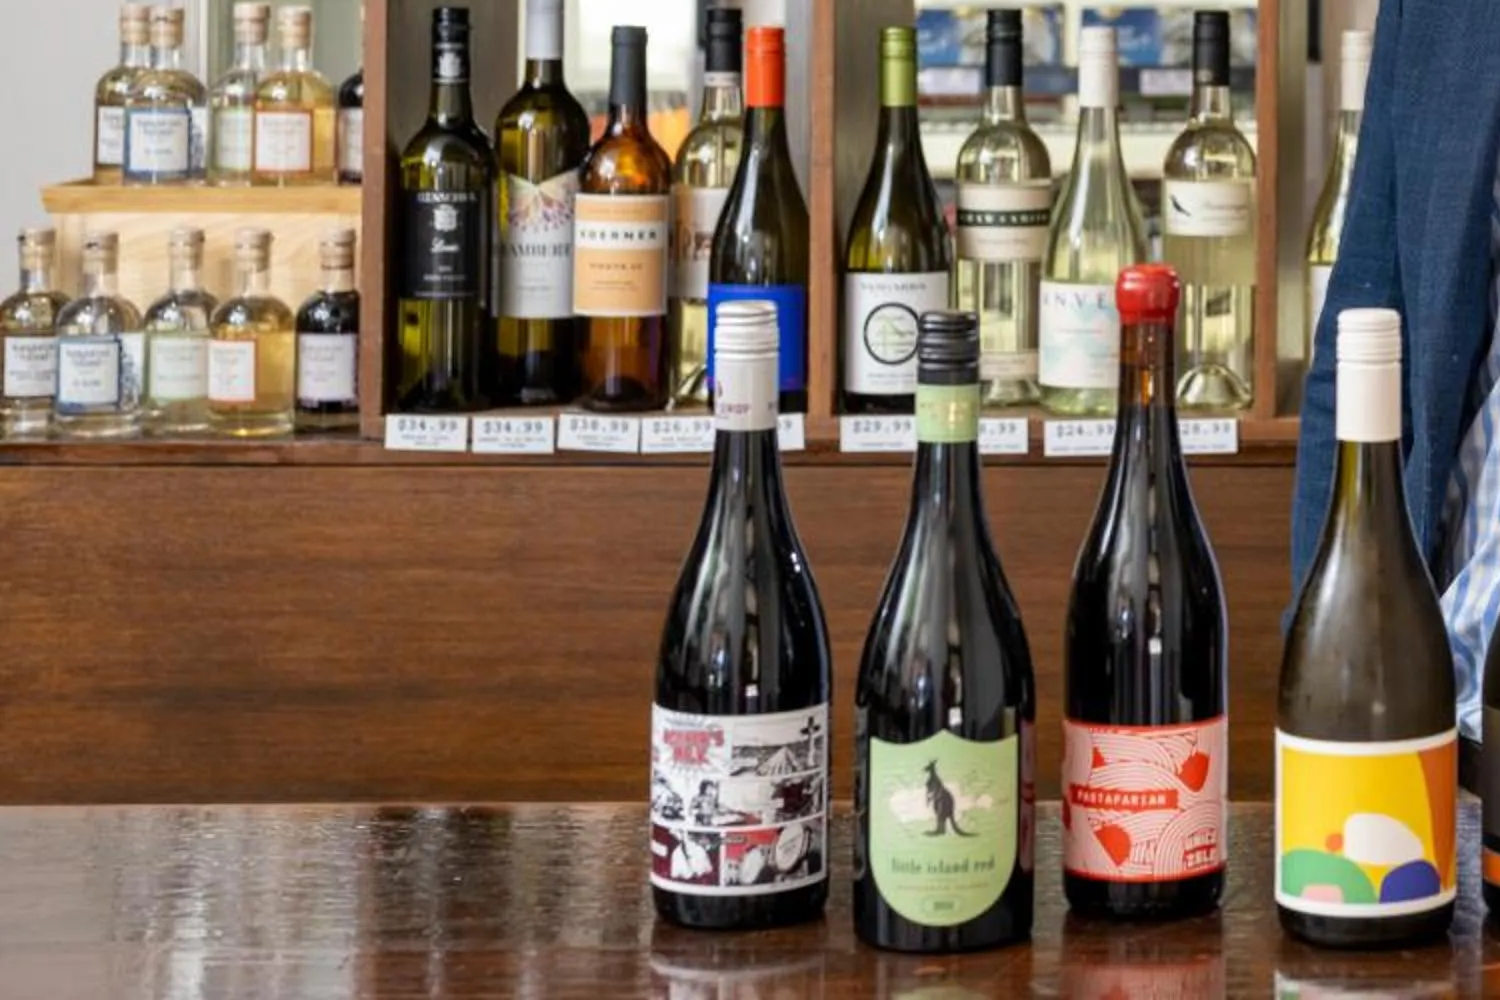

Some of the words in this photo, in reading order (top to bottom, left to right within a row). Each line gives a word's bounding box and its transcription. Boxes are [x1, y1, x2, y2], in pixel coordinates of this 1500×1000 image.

[892, 857, 922, 873] little
[926, 857, 970, 874] island
[973, 856, 995, 871] red
